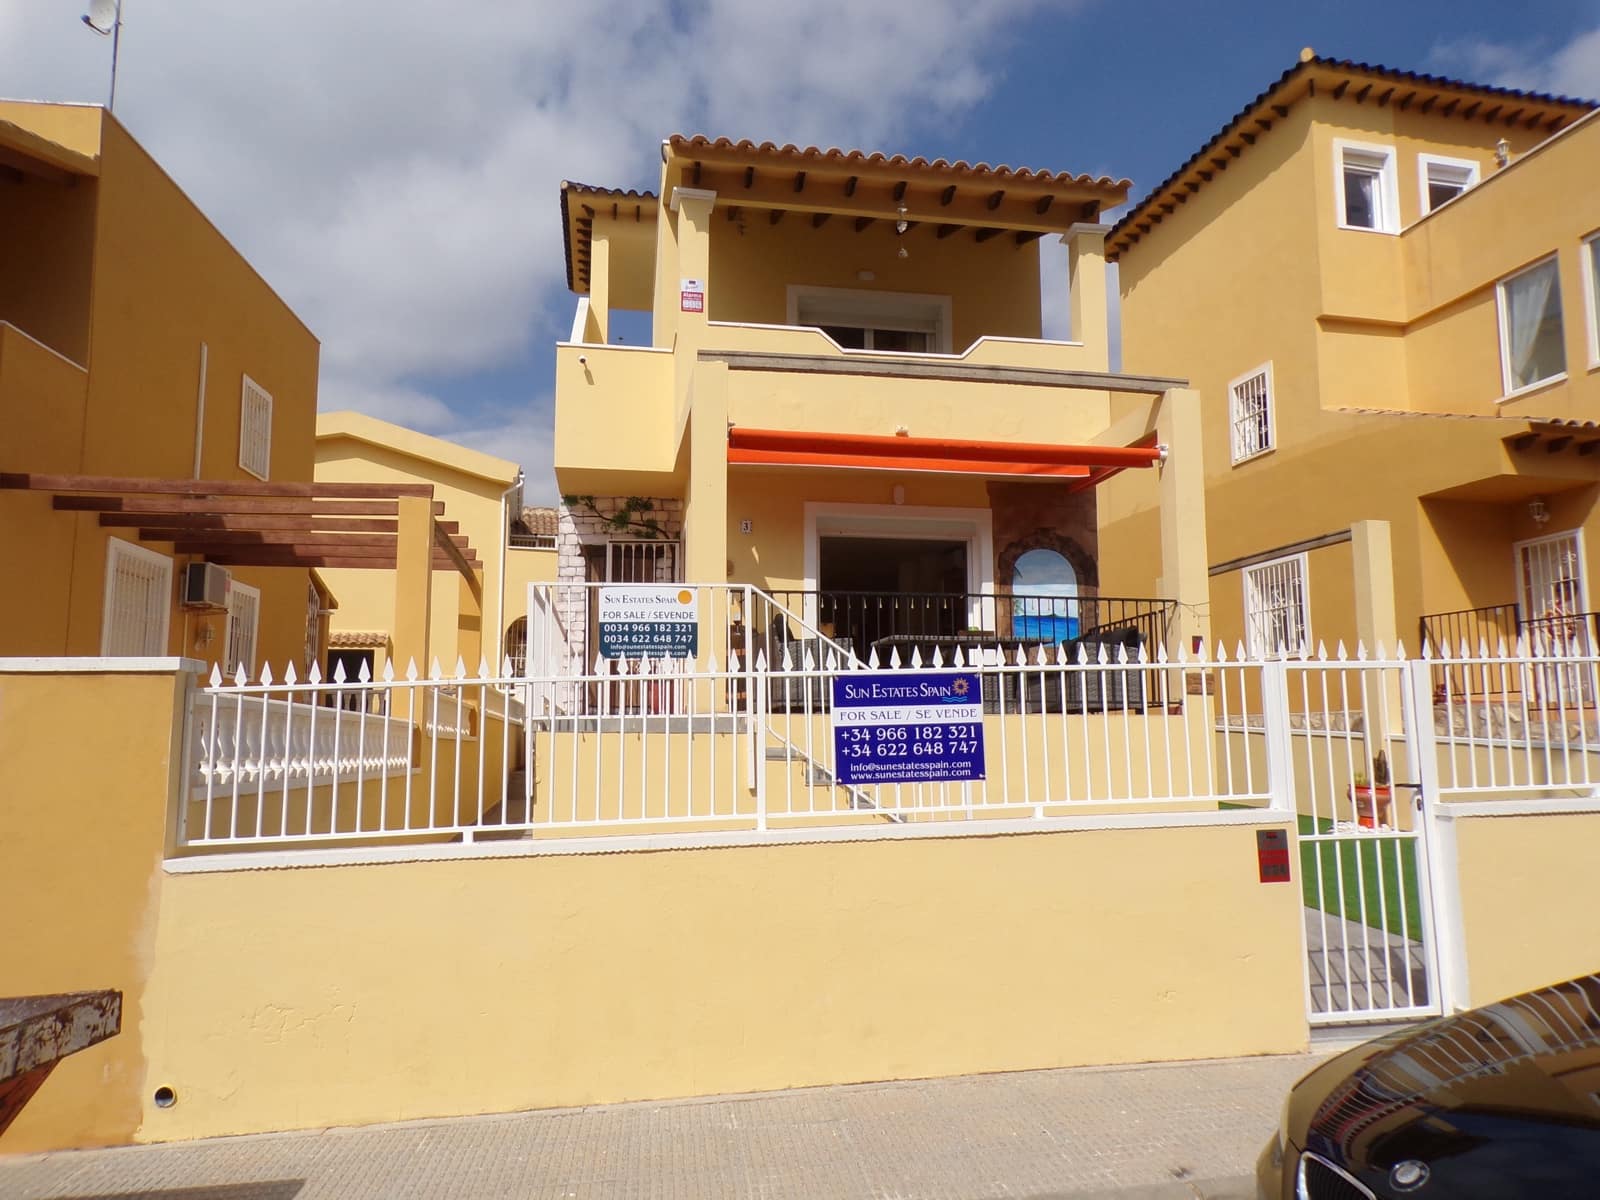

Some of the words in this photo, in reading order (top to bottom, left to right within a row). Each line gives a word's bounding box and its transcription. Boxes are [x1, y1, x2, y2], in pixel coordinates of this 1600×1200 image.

[604, 594, 620, 604] SUN
[622, 594, 654, 604] ESTATES
[655, 594, 677, 604] SPAIN
[603, 611, 621, 619] FOR
[623, 611, 646, 619] SALE
[653, 611, 694, 619] SEVENDE
[604, 624, 629, 632] 0034
[632, 624, 650, 632] 966
[654, 624, 672, 632] 182
[674, 624, 692, 632] 321
[604, 635, 629, 643] 0034
[632, 635, 650, 643] 622
[653, 635, 672, 643] 648
[675, 635, 693, 643] 747
[845, 684, 870, 699] SUN
[872, 683, 918, 698] ESTATES
[920, 682, 951, 697] SPAIN
[840, 711, 866, 721] FOR
[870, 710, 901, 720] SALE
[915, 709, 931, 719] SE
[935, 708, 977, 718] VENDE
[841, 728, 871, 741] +34
[876, 727, 907, 741] 966
[915, 726, 942, 740] 182
[948, 725, 976, 739] 321
[842, 744, 872, 757] +34
[877, 743, 907, 756] 622
[913, 742, 944, 755] 648
[949, 741, 978, 754] 747
[850, 760, 972, 772] info@sunestatesspain.com
[850, 769, 971, 780] www.sunestatesspain.com
